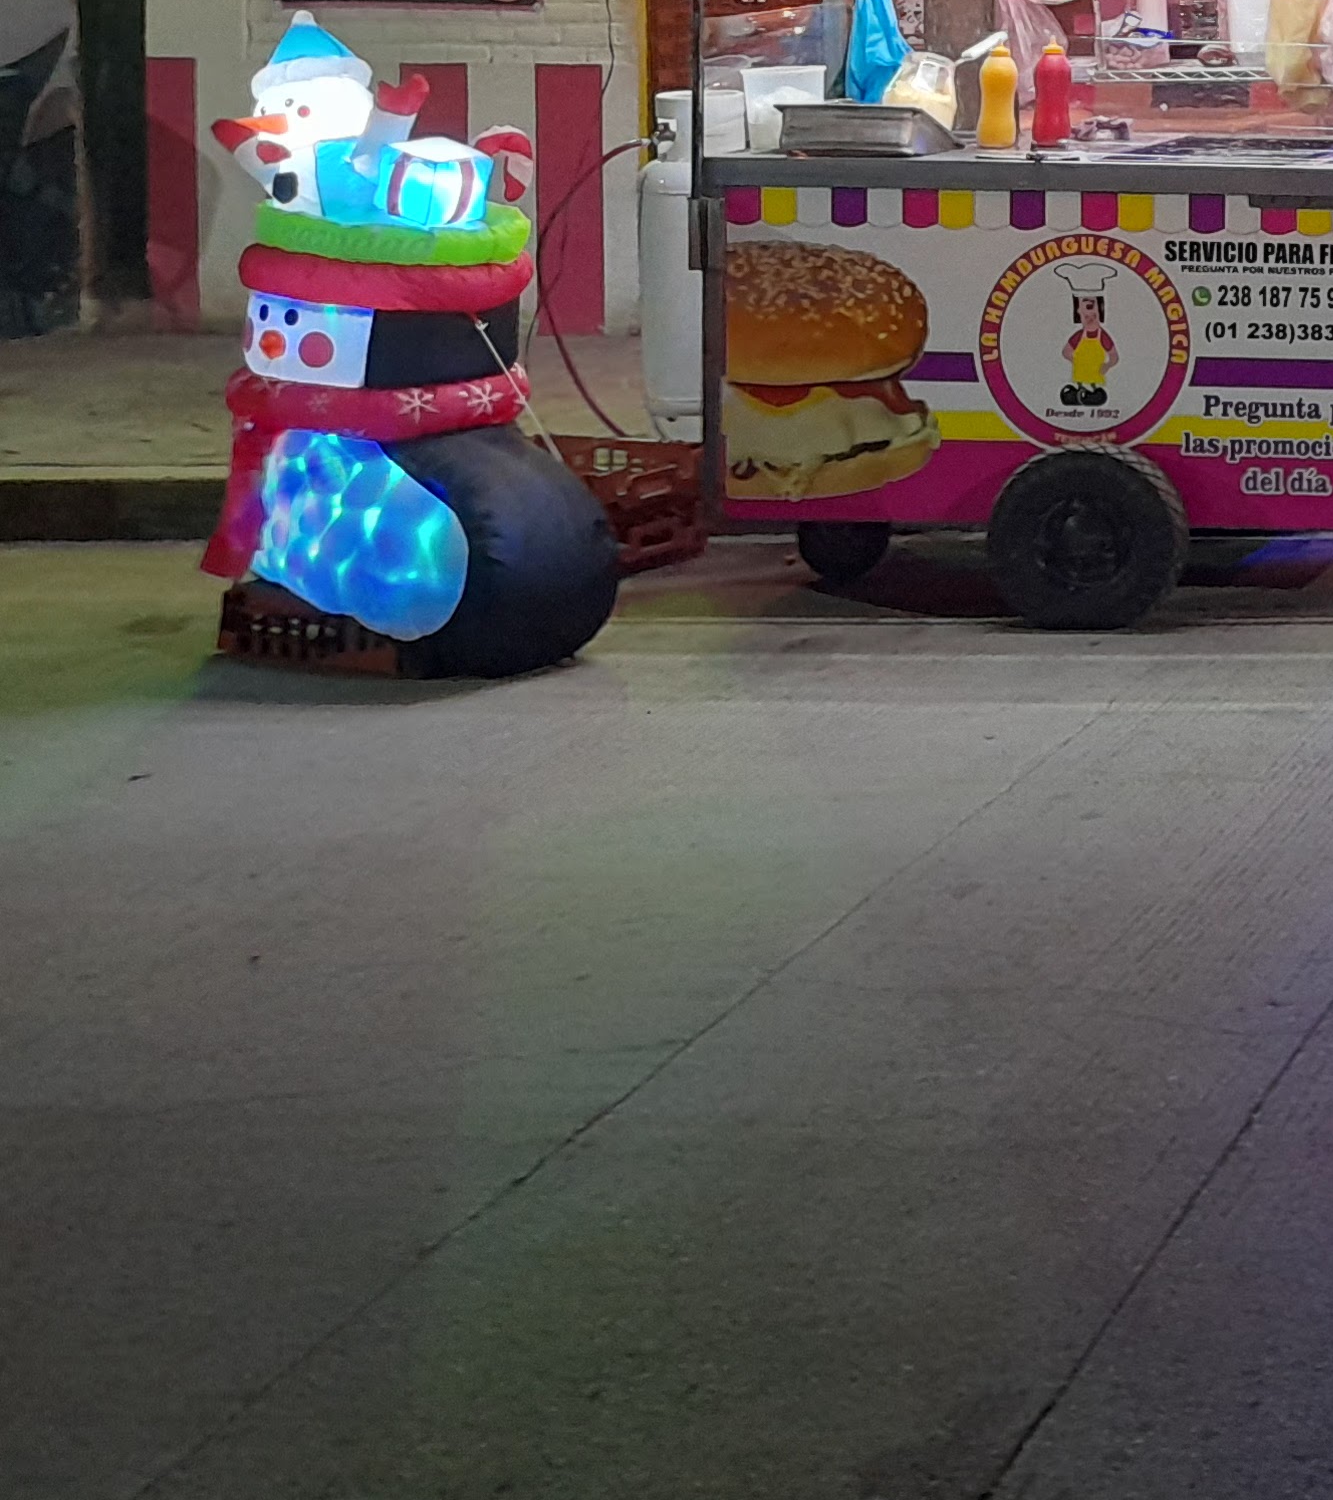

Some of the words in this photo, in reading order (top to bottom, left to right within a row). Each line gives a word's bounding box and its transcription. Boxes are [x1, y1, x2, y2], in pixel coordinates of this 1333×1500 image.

[1164, 240, 1258, 264] SERVICIO
[1263, 242, 1315, 265] PARA
[1180, 265, 1239, 274] PREGUNTA
[1242, 266, 1264, 274] POR
[1267, 266, 1326, 275] NUESTROS
[1217, 284, 1252, 307] 238
[1258, 285, 1293, 308] 187
[1298, 286, 1321, 309] 75
[1144, 265, 1189, 365] MAGICA
[1204, 321, 1238, 343] (01
[1044, 408, 1085, 418] Desde
[1202, 394, 1322, 424] Pregunta
[1183, 432, 1221, 454] las
[1243, 469, 1282, 492] del
[1289, 468, 1329, 493] día
